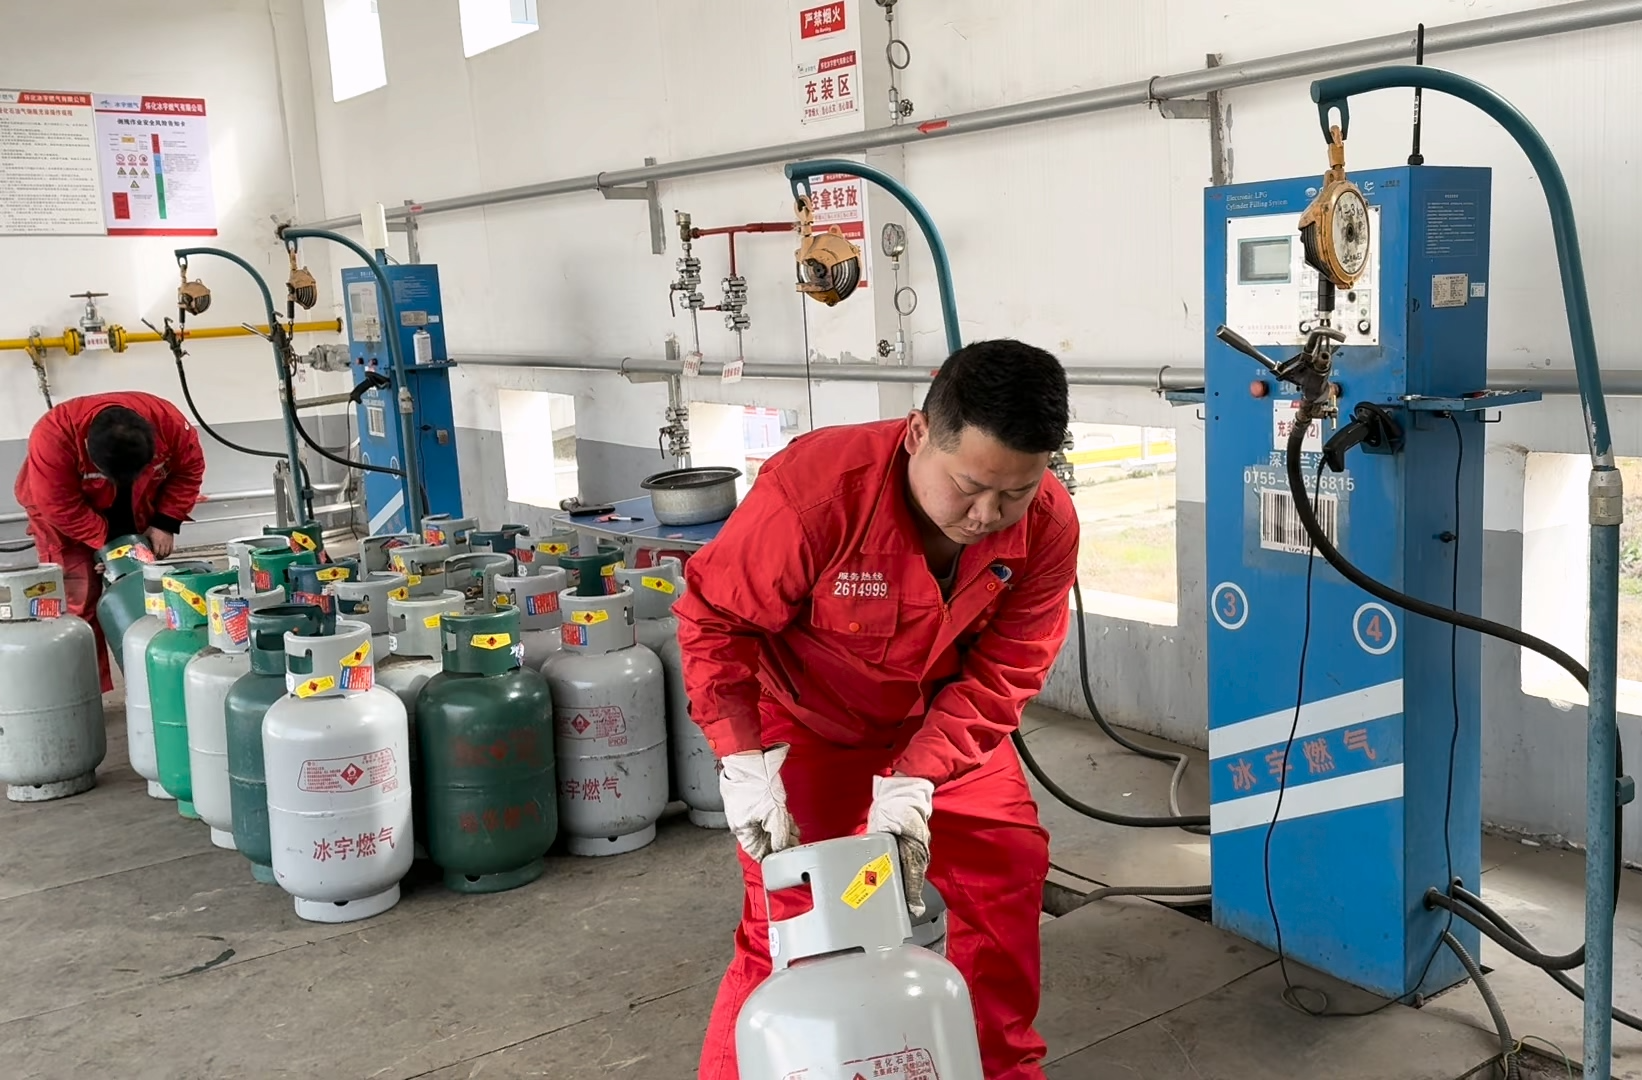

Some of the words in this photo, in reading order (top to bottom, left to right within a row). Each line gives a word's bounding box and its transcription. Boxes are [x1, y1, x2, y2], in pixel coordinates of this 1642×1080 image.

[804, 5, 841, 29] 严禁烟火
[805, 73, 850, 104] 充装区
[1226, 202, 1249, 211] Cylinder
[1249, 200, 1268, 208] Filling
[1254, 191, 1268, 199] LPG
[1244, 470, 1355, 491] 0755-8836815
[837, 572, 883, 581] 服务热线
[834, 581, 887, 597] 2614999
[1223, 592, 1237, 617] 3
[1366, 615, 1383, 642] 4
[1227, 728, 1377, 791] 冰宇燃气
[313, 826, 395, 862] 冰宇燃气
